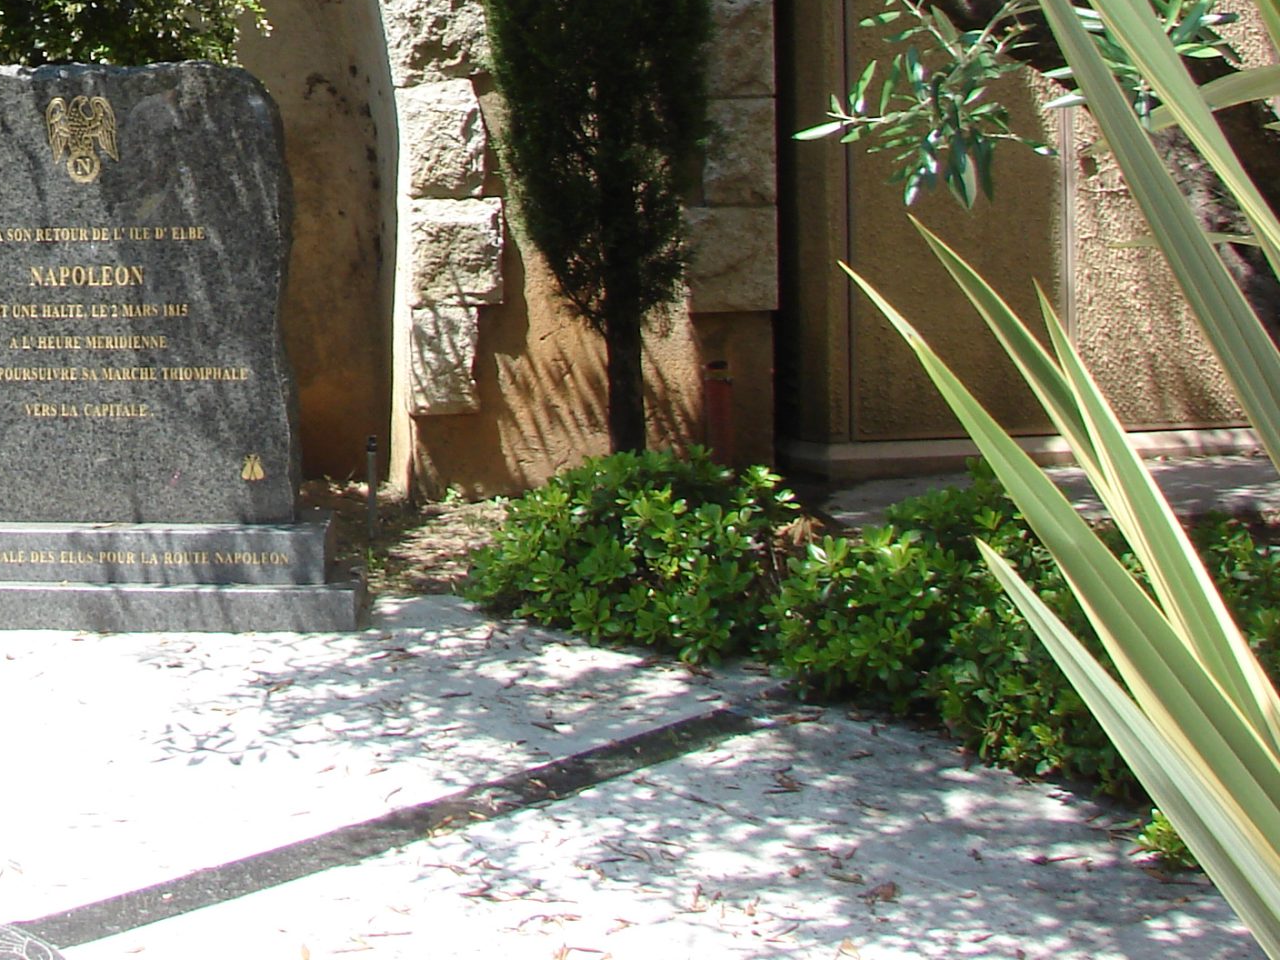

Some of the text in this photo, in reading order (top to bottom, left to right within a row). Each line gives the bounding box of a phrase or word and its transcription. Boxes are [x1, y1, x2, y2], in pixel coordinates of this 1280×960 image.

[7, 228, 32, 241] SON
[36, 228, 89, 241] RETOUR
[92, 228, 109, 241] DE
[29, 265, 145, 286] NAPOLEON
[12, 304, 37, 318] UNE
[92, 304, 107, 318] LE
[111, 304, 118, 318] 2
[122, 304, 158, 318] MARS
[163, 304, 188, 317] 1815
[9, 336, 18, 349] A
[85, 336, 167, 349] MERIDIENNE
[82, 367, 97, 380] SA
[102, 367, 157, 380] MARCHE
[161, 367, 248, 380] TRIOMPHALE
[25, 404, 57, 417] VERS
[61, 404, 78, 417] LA
[31, 551, 55, 563] DES
[60, 551, 94, 563] ELUS
[99, 551, 135, 564] POUR
[141, 551, 158, 564] LA
[164, 551, 209, 564] ROUTE
[215, 552, 289, 564] NAPOLEON
